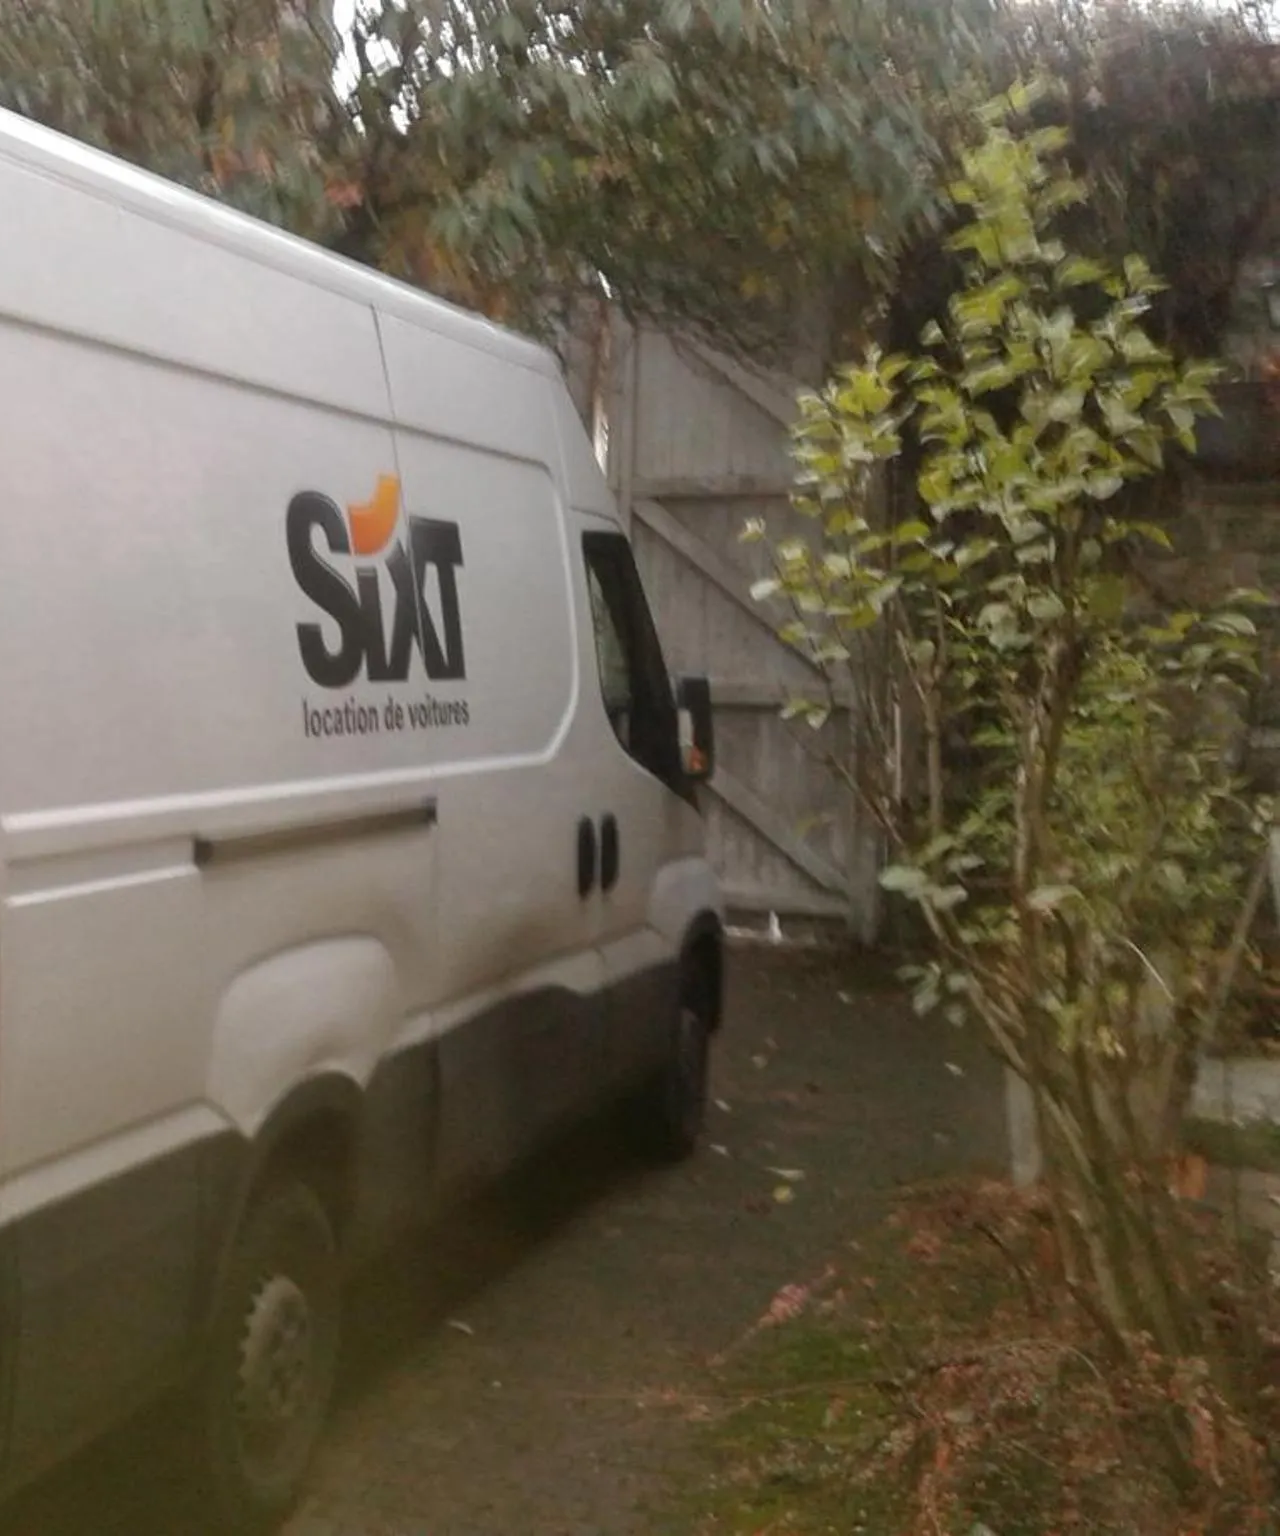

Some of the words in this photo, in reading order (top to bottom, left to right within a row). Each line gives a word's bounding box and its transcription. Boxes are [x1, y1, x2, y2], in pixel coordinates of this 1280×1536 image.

[302, 695, 380, 738] location
[384, 694, 405, 731] de
[407, 693, 470, 730] voitures
